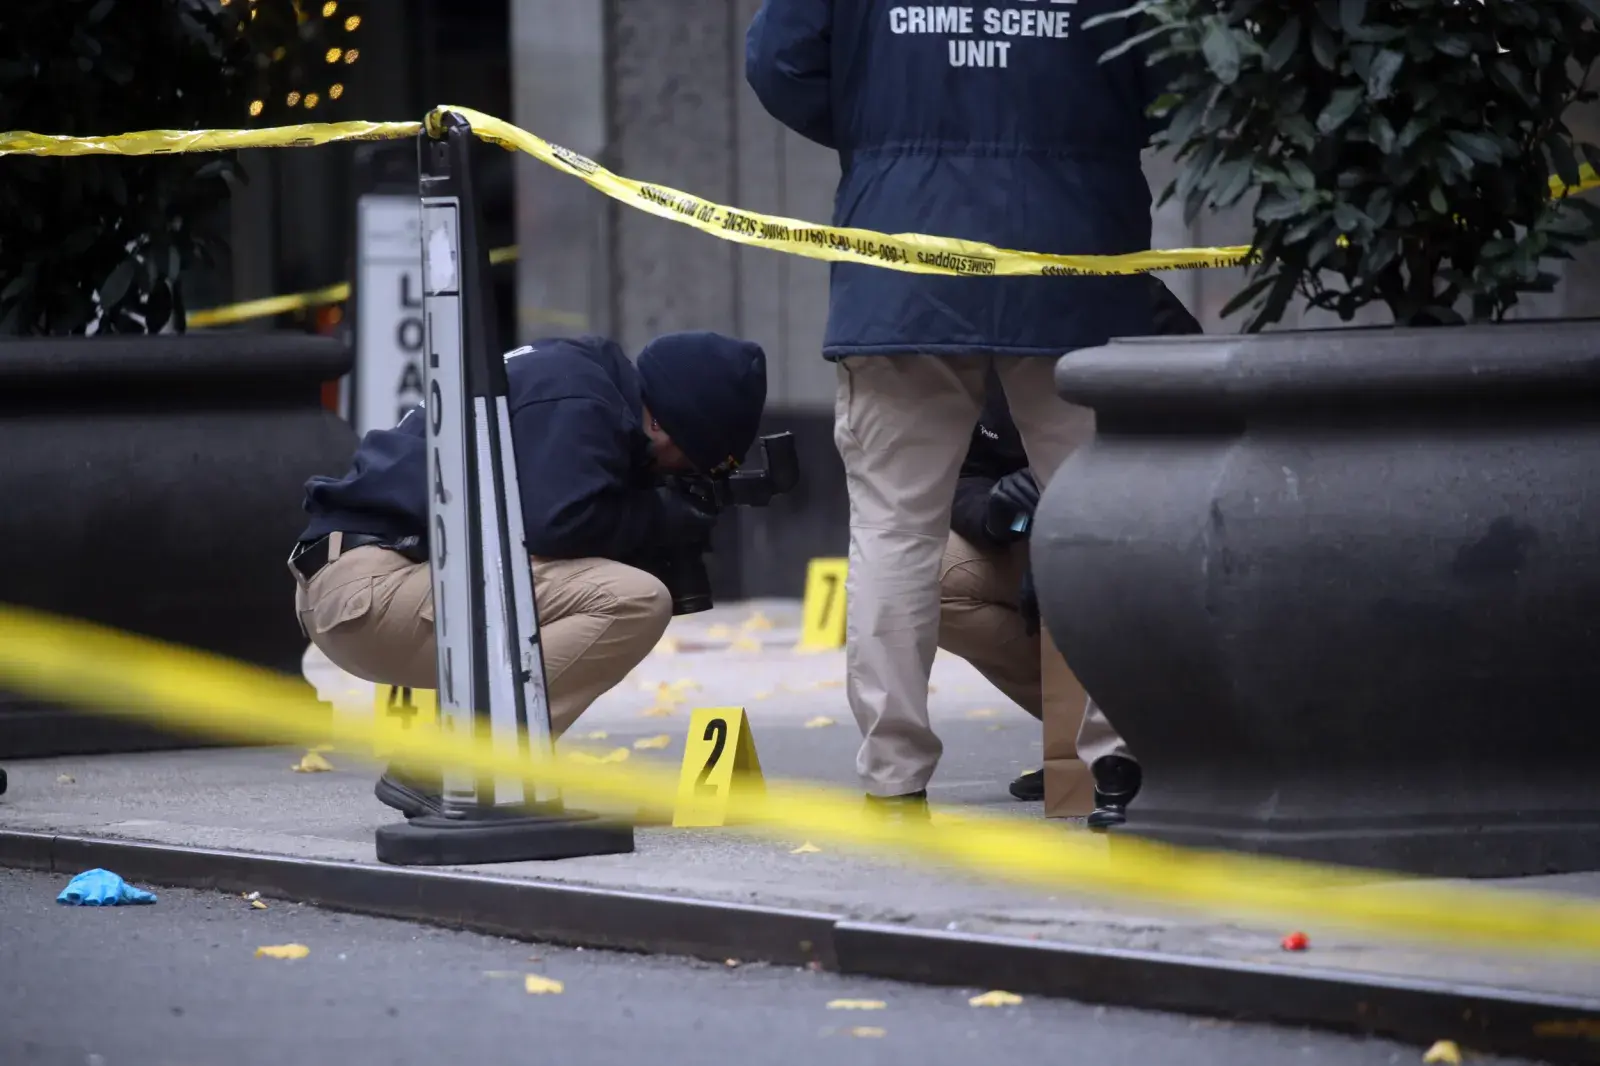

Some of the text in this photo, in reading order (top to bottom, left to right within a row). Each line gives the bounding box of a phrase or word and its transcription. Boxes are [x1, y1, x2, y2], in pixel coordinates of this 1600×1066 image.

[889, 6, 1070, 38] CRIME SCENE
[949, 40, 1010, 68] UNIT
[696, 205, 716, 223] DO
[721, 211, 757, 236] SCENE
[757, 222, 790, 241] CRIME
[818, 573, 839, 631] 7
[386, 685, 418, 730] 4
[694, 718, 728, 797] 2
